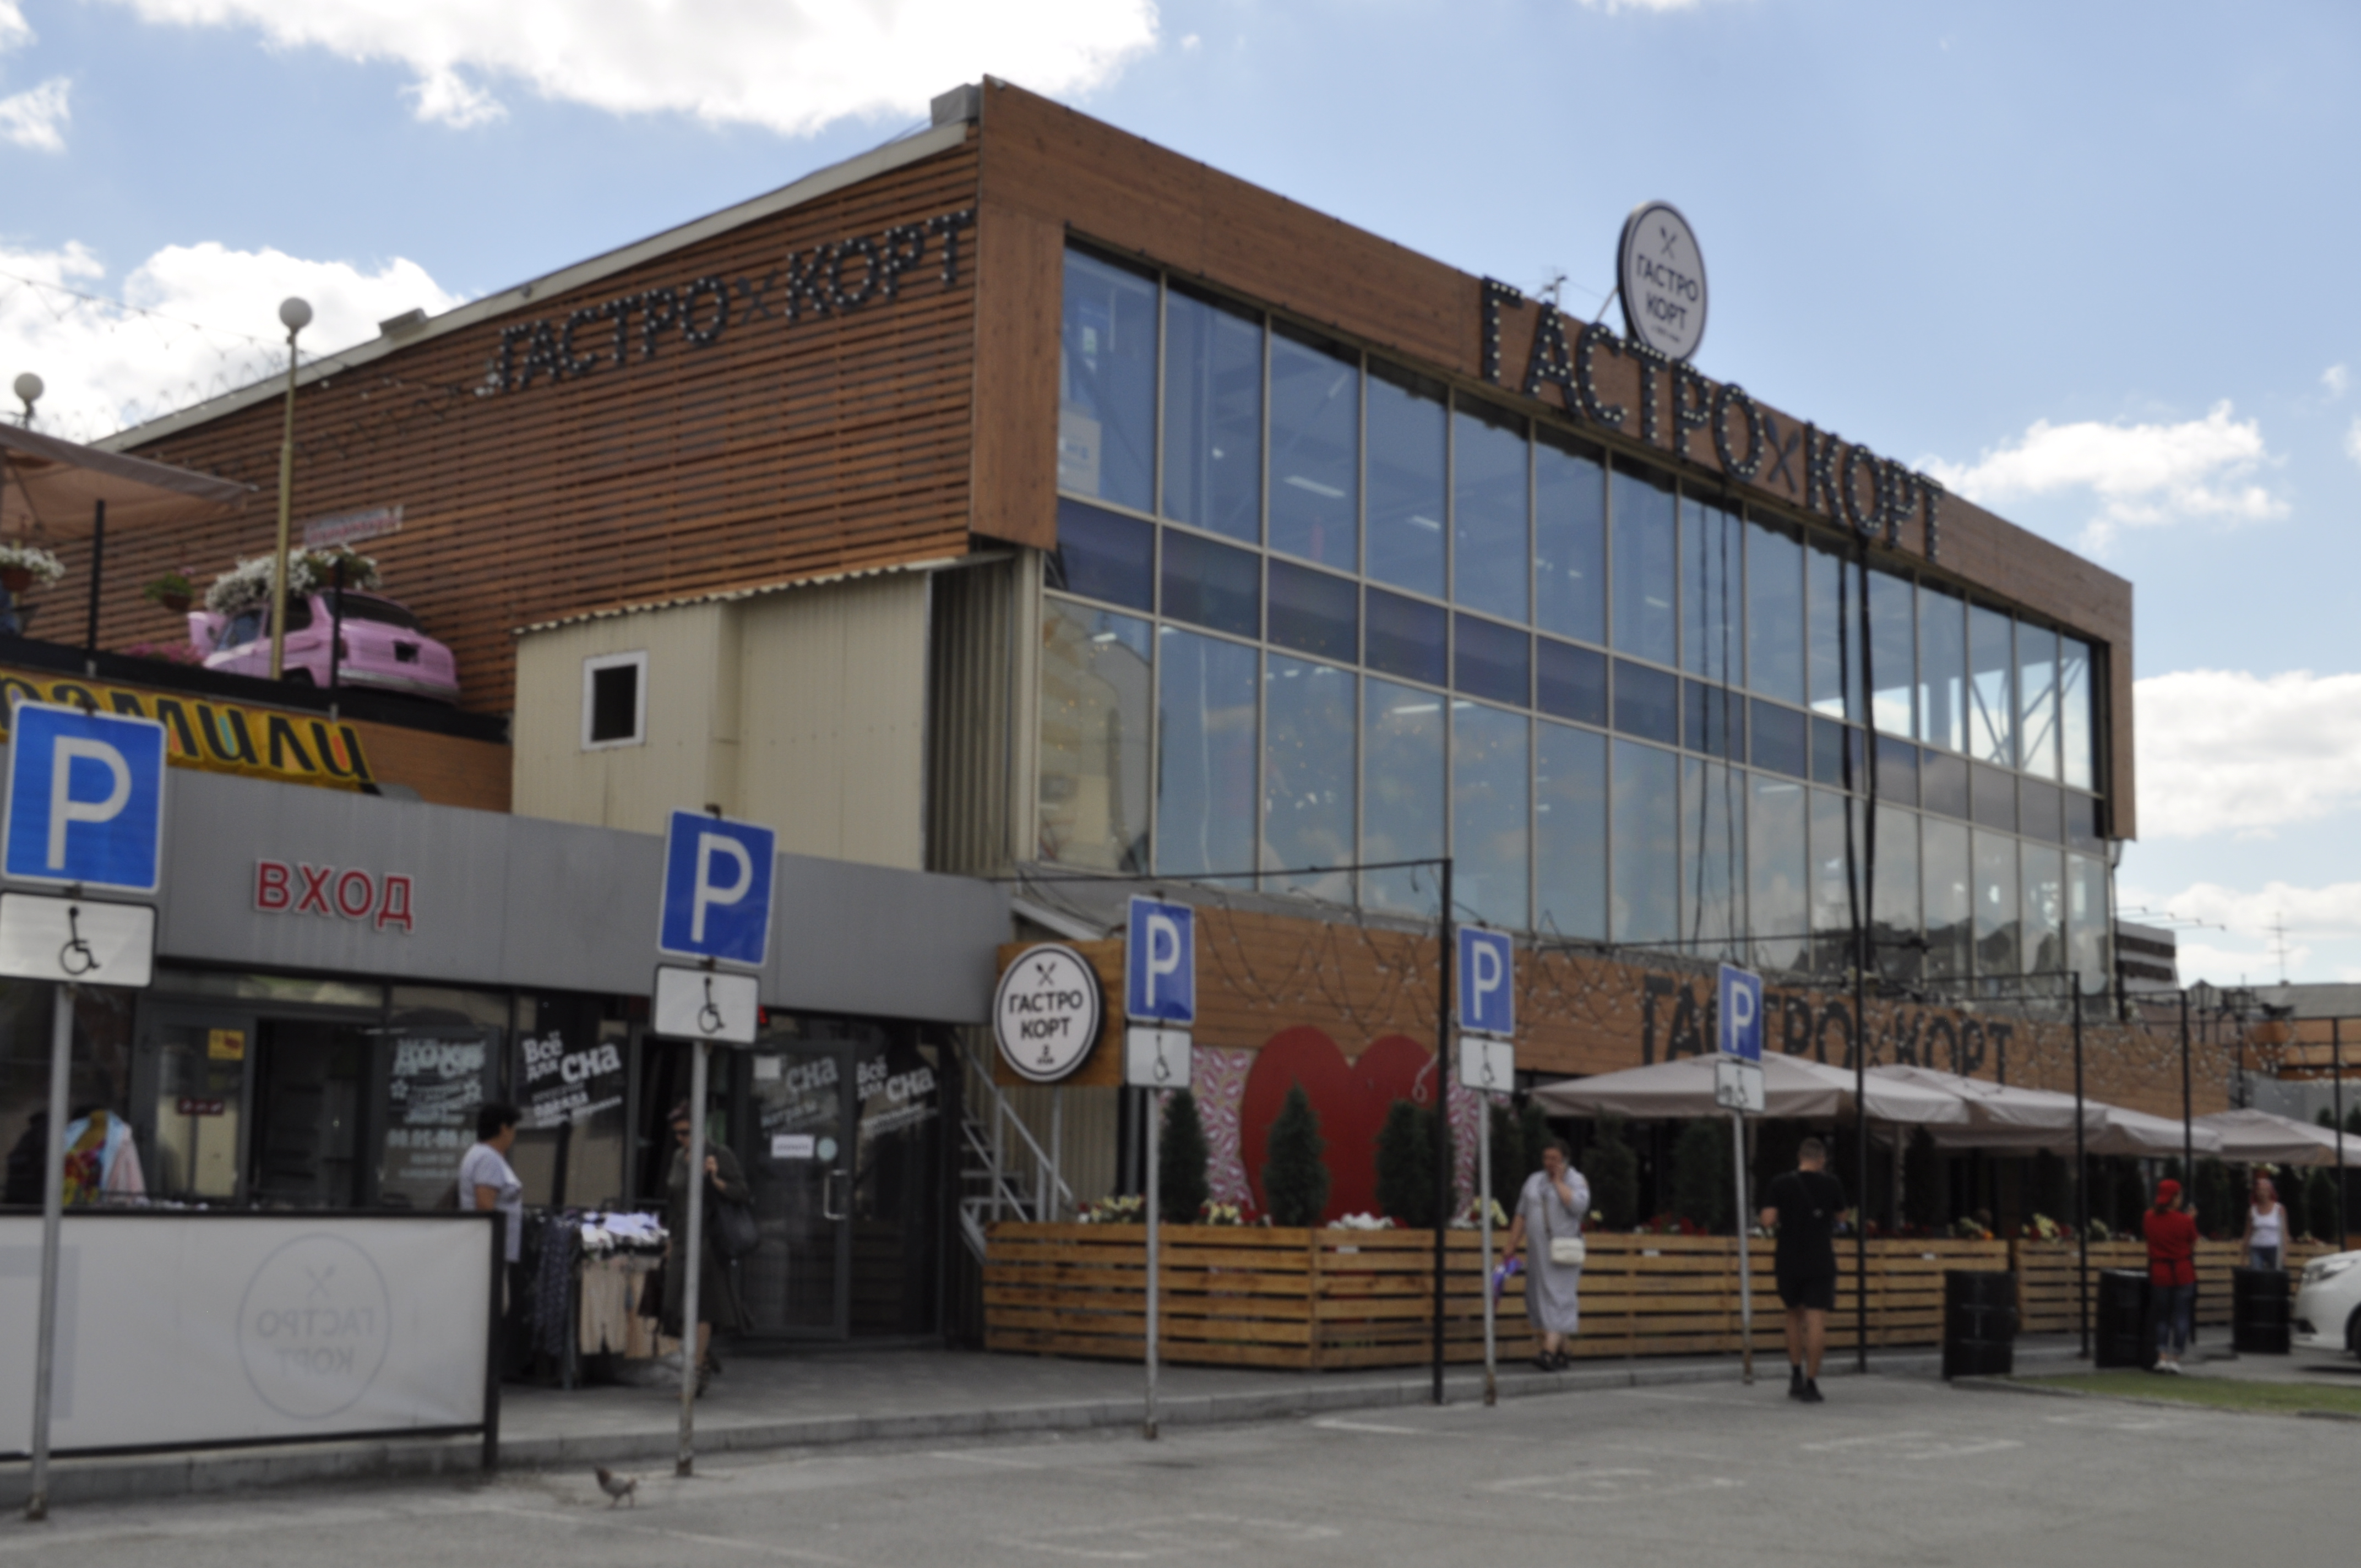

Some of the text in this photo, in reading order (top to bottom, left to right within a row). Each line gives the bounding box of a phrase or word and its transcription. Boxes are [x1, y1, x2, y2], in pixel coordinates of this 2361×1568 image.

[499, 208, 976, 393] ГАСТРО КОРТ
[1638, 254, 1699, 302] ГАСТРО
[1646, 291, 1687, 330] КОРТ
[1481, 275, 1944, 562] ГАСТРО КОРТ
[47, 735, 132, 870] P
[257, 861, 412, 930] ВХОД
[690, 831, 753, 943] P
[1009, 989, 1083, 1014] ГАСТРО
[1145, 914, 1180, 1008] P
[1471, 940, 1503, 1021] P
[1020, 1017, 1070, 1041] КОРТ
[1643, 974, 1854, 1070] ГАРО
[1730, 980, 1755, 1051] P
